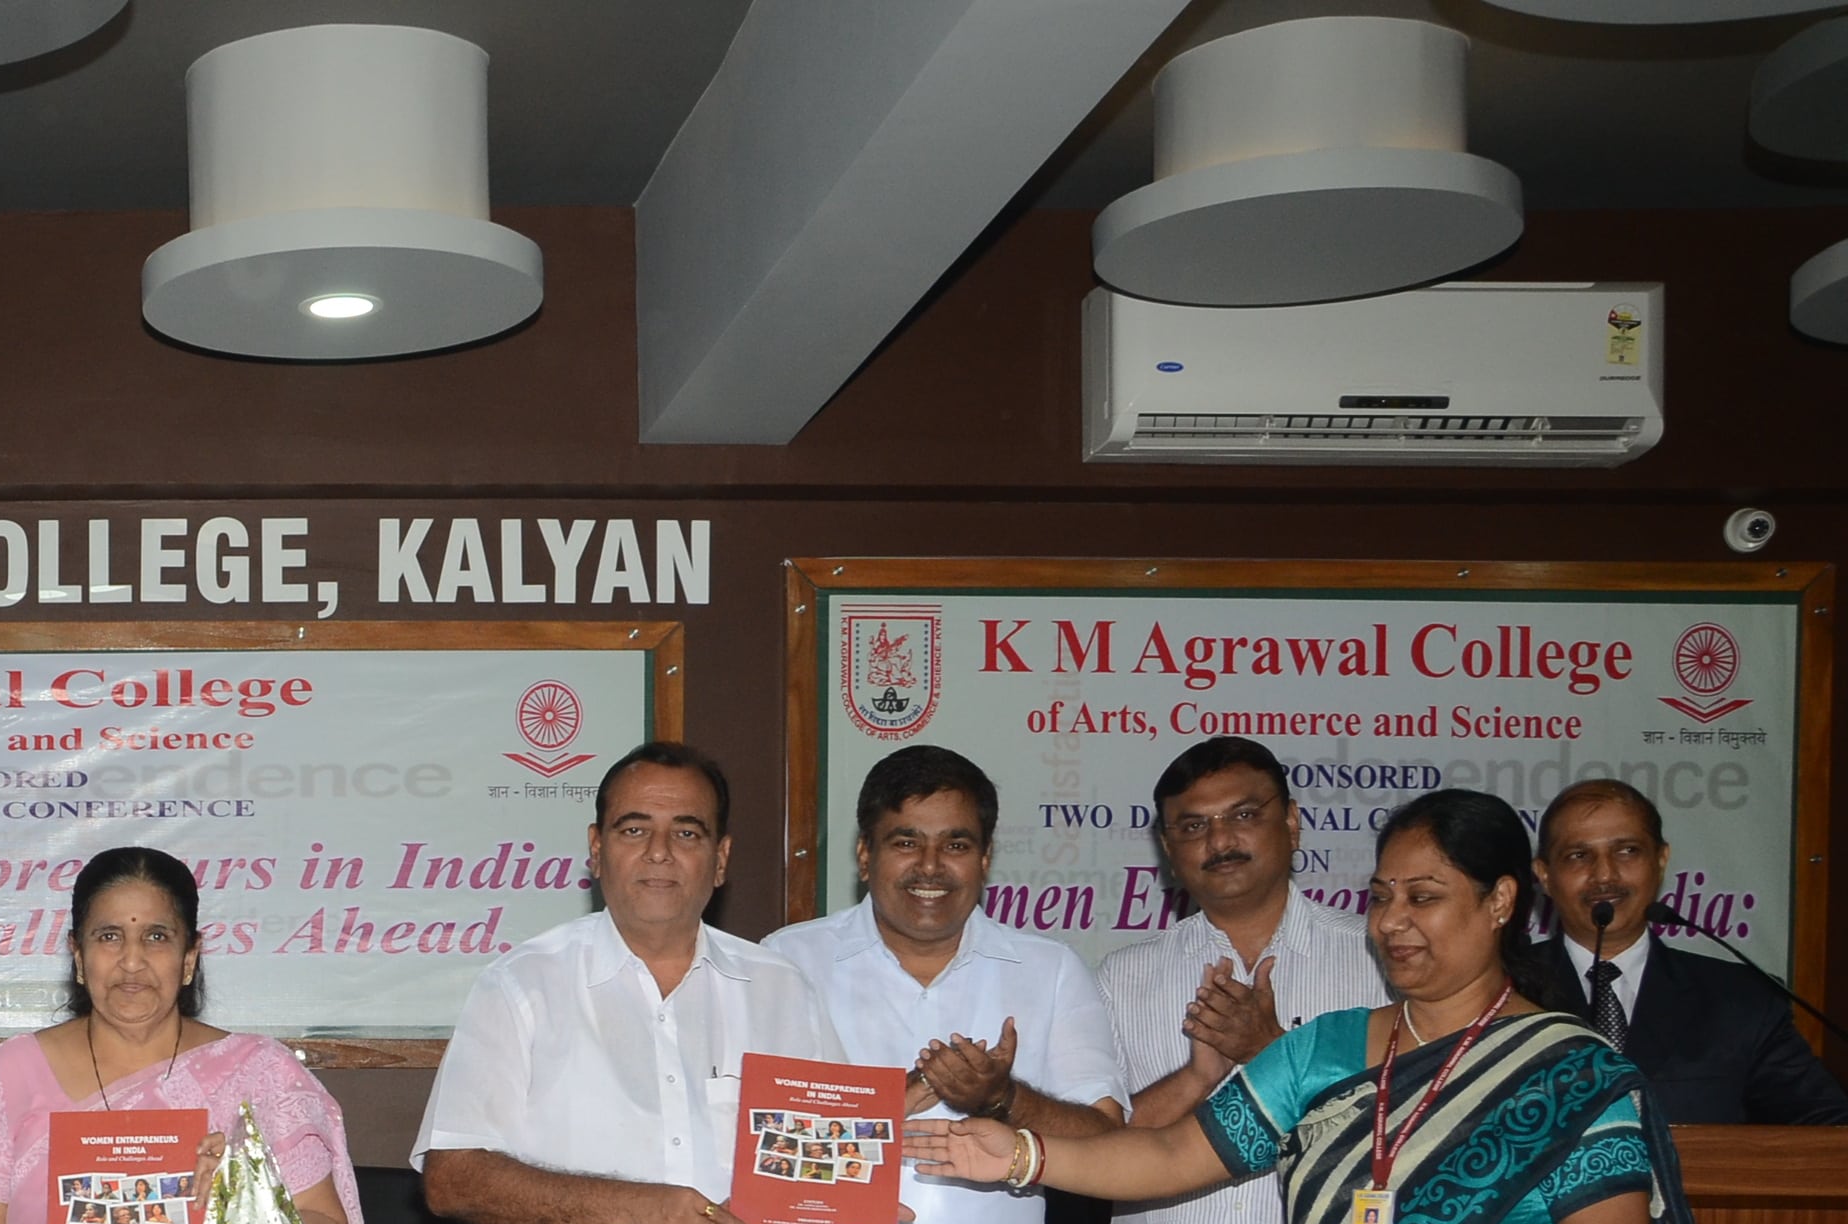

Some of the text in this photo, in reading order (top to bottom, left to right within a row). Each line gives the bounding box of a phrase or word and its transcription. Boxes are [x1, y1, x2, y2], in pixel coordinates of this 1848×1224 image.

[379, 517, 711, 606] KALYAN
[978, 619, 1633, 696] K M Agrawal College
[49, 667, 314, 718] College
[1027, 700, 1582, 741] of Arts, Commerce and Science
[8, 727, 83, 752] and
[98, 726, 255, 751] Science
[1283, 763, 1442, 790] PONSORED
[2, 800, 255, 820] CONFERENCE
[1039, 804, 1113, 829] TWO
[299, 842, 365, 890] in
[272, 905, 513, 954] Ahead.
[774, 1077, 809, 1089] WOMEN
[806, 1090, 842, 1101] IN INDIA
[80, 1135, 179, 1145] WOMEN ENTREPRENEURS
[112, 1145, 146, 1155] IN INDIA
